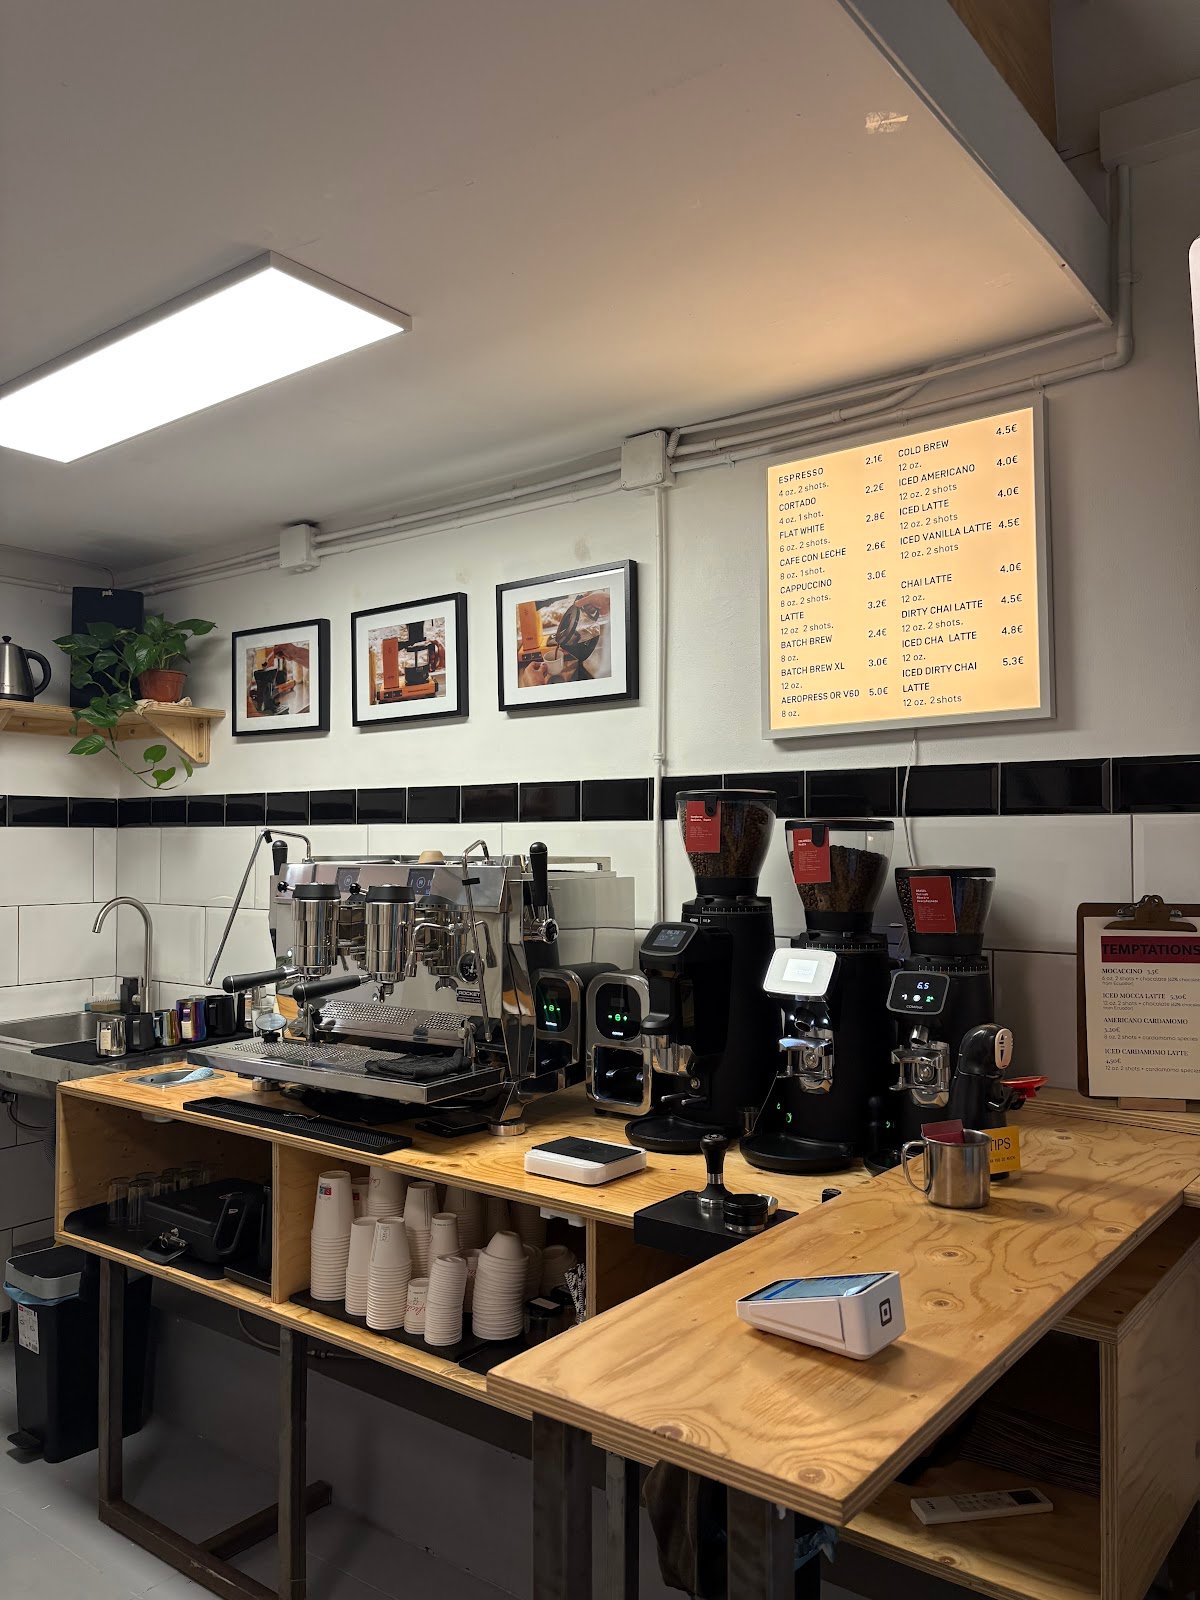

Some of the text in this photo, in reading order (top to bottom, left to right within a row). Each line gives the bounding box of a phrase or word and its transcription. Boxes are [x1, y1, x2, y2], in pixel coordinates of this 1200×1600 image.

[898, 424, 1017, 457] COLD BREW 4.5€
[779, 454, 882, 484] ESPRESSO 2.1€
[899, 461, 922, 471] 12 oz.
[899, 455, 1018, 486] ICED AMERICANO 4.0€
[805, 481, 829, 492] shots.
[910, 490, 923, 499] oz.
[925, 488, 930, 496] 2
[932, 483, 957, 494] shots
[779, 483, 884, 511] CORTADO 2.2€
[899, 486, 1019, 516] ICED LATTE 4.0€
[780, 512, 885, 539] FLAT WHITE 2.8€
[900, 522, 908, 530] 12
[926, 518, 931, 526] 2
[933, 513, 958, 524] shots
[900, 518, 1020, 545] ICED VANILLA LATTE 4.5€
[787, 543, 797, 551] oz.
[800, 541, 804, 549] 2
[806, 538, 830, 547] shots.
[901, 551, 909, 559] 12
[926, 547, 932, 555] 2
[934, 544, 959, 554] shots
[780, 541, 885, 567] CAFE CON LECHE 2.6€
[780, 570, 886, 594] CAPPUCCINO 3.0€
[901, 562, 1021, 589] CHAI LATTE 4.0€
[780, 600, 785, 608] 8
[787, 599, 798, 607] oz.
[806, 594, 831, 604] shots.
[901, 594, 925, 603] 12 oz.
[901, 594, 1022, 618] DIRTY CHAI LATTE 4.5€
[780, 599, 886, 621] LATTE 3.2€
[781, 627, 788, 635] 12
[809, 623, 834, 632] shots.
[902, 624, 910, 632] 12
[928, 621, 933, 629] 2
[935, 619, 963, 628] shots.
[781, 628, 887, 649] BATCH BREW 2.4€
[902, 638, 922, 648] ICED
[948, 631, 977, 642] LATTE
[1001, 625, 1023, 635] 4.8€
[902, 654, 910, 662] 12
[781, 658, 887, 676] BATCH BREW XL 3.0€
[902, 656, 1024, 678] ICED DIRTY CHAI 5.3€
[781, 682, 789, 690] 12
[902, 682, 930, 692] LATTE
[781, 693, 828, 704] AEROPRESS
[830, 691, 841, 699] OR
[869, 687, 888, 696] 5.0€
[1102, 944, 1200, 955] TEMPTATIONS
[991, 1137, 1010, 1151] TIPS
